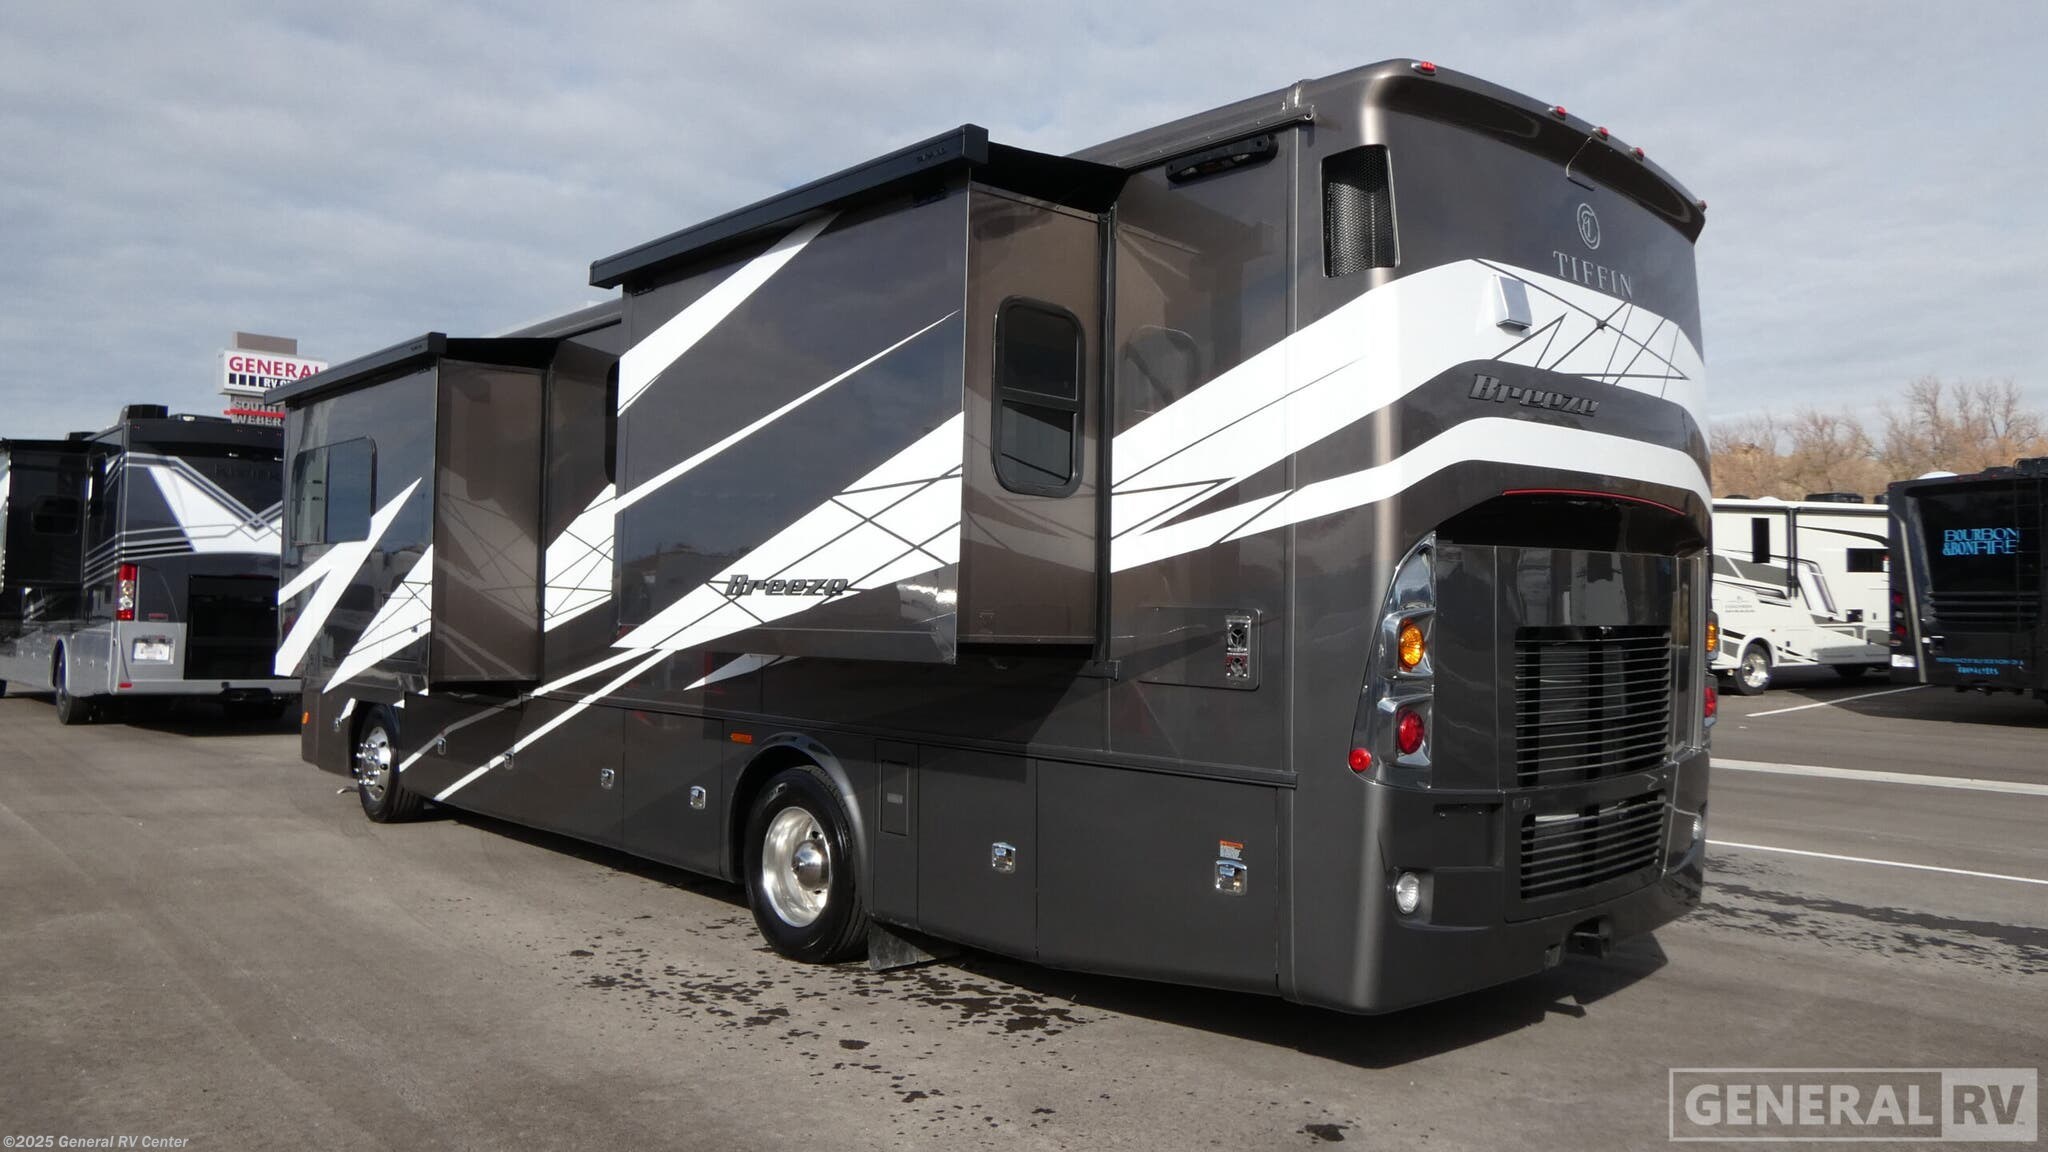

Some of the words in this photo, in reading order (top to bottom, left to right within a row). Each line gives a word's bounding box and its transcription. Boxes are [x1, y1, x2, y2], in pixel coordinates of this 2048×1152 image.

[1552, 250, 1633, 301] TIFFIN
[1469, 373, 1600, 417] Breeze
[231, 414, 282, 427] WEBER
[1944, 527, 2020, 542] BOURBON
[724, 574, 849, 596] Breeze
